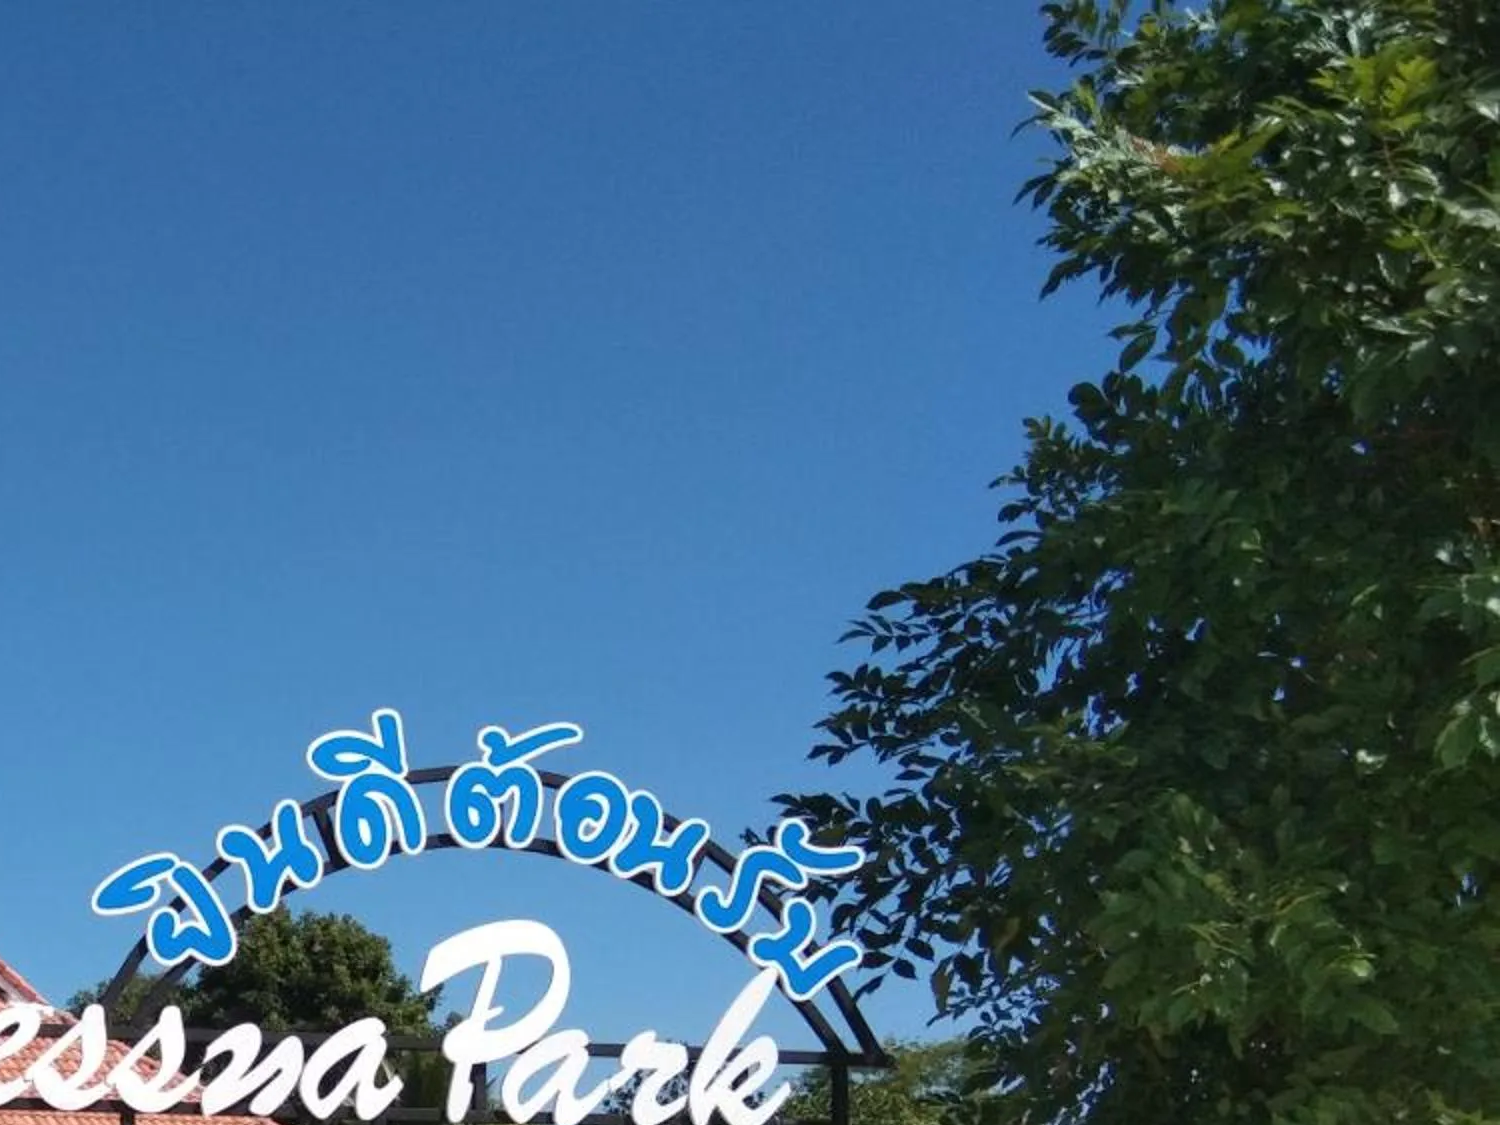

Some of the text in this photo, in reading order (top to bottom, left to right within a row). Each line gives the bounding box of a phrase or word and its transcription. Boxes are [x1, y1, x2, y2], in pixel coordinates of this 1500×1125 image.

[92, 708, 865, 1001] ยินดีต้อนรับ
